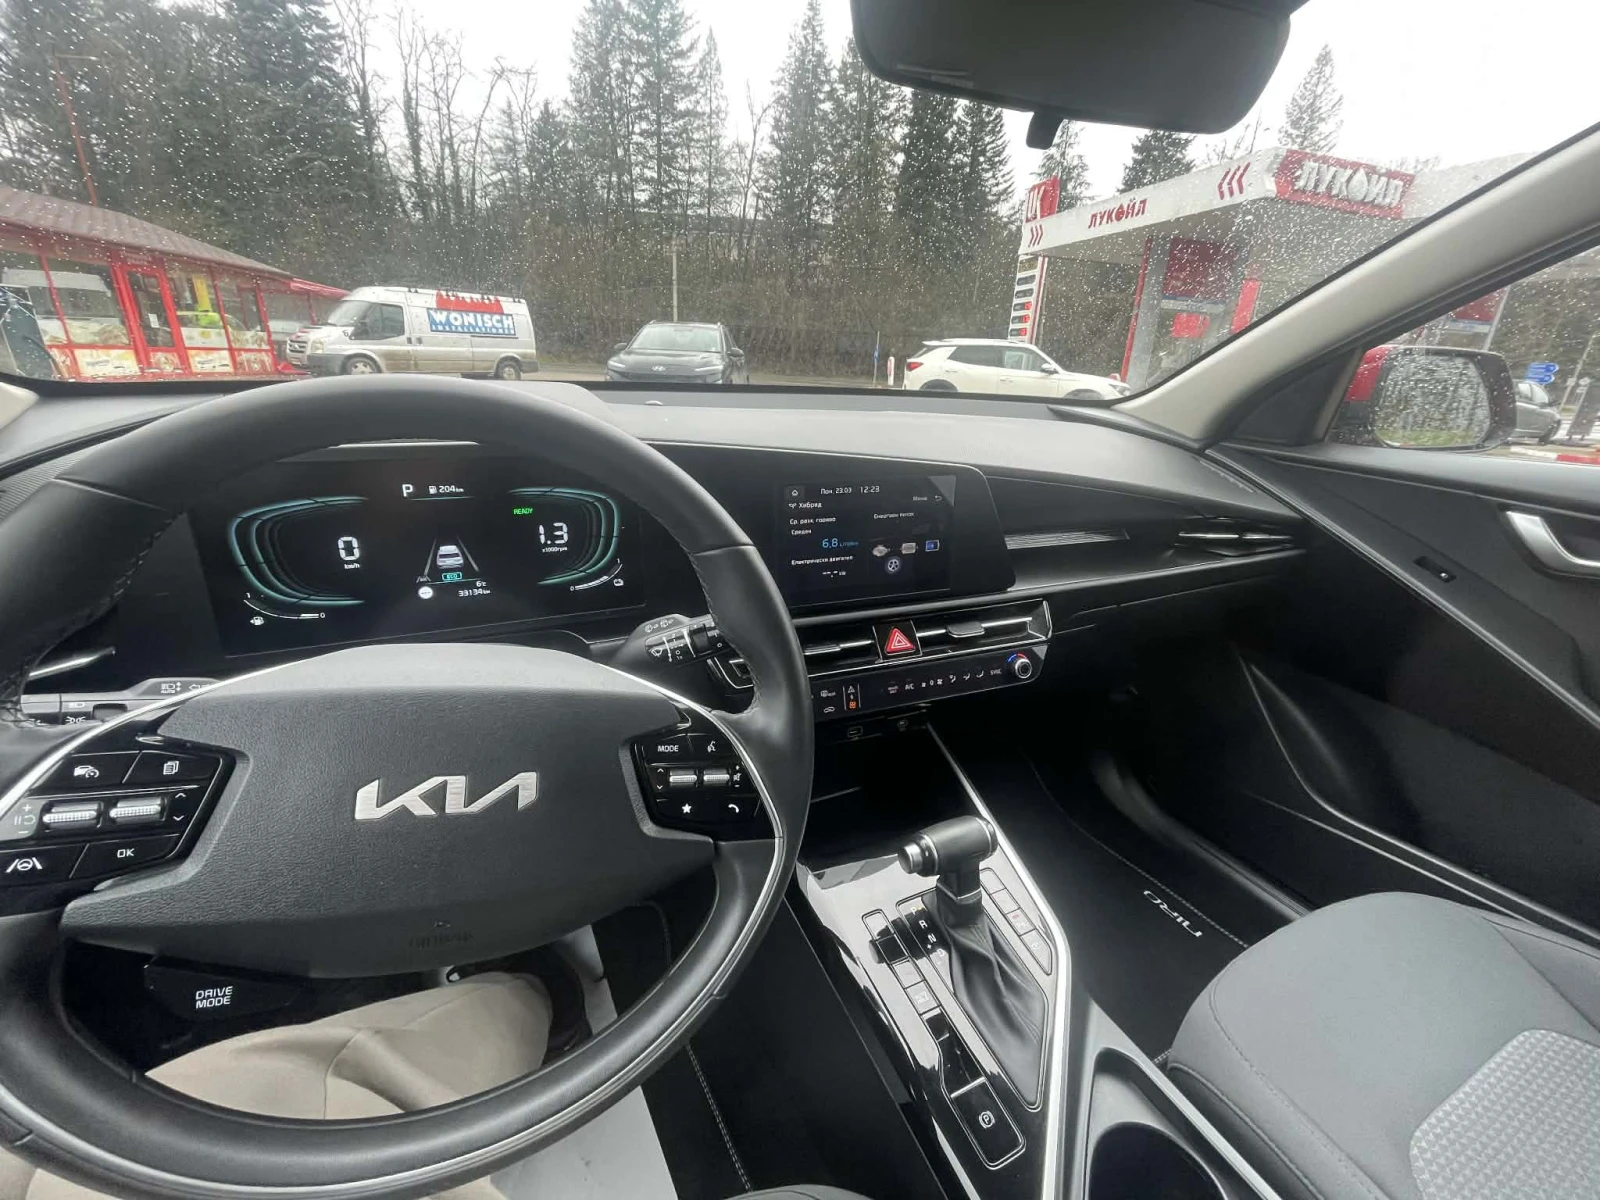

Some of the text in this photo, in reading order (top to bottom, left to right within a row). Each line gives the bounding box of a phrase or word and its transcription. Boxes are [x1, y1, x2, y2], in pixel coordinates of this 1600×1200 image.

[1088, 198, 1148, 229] ЛУКОЙЛ
[429, 309, 514, 329] WONISCH
[402, 484, 414, 497] P
[860, 485, 880, 494] 12:23
[513, 507, 533, 515] READY
[538, 522, 569, 545] 1.3
[337, 536, 361, 561] 0
[822, 537, 839, 549] 6.8
[657, 744, 680, 753] MODE
[355, 771, 538, 820] KIA
[116, 848, 135, 858] OK
[918, 919, 928, 929] R
[927, 933, 937, 943] N
[195, 985, 233, 1000] DRIVE
[195, 995, 232, 1009] MODE
